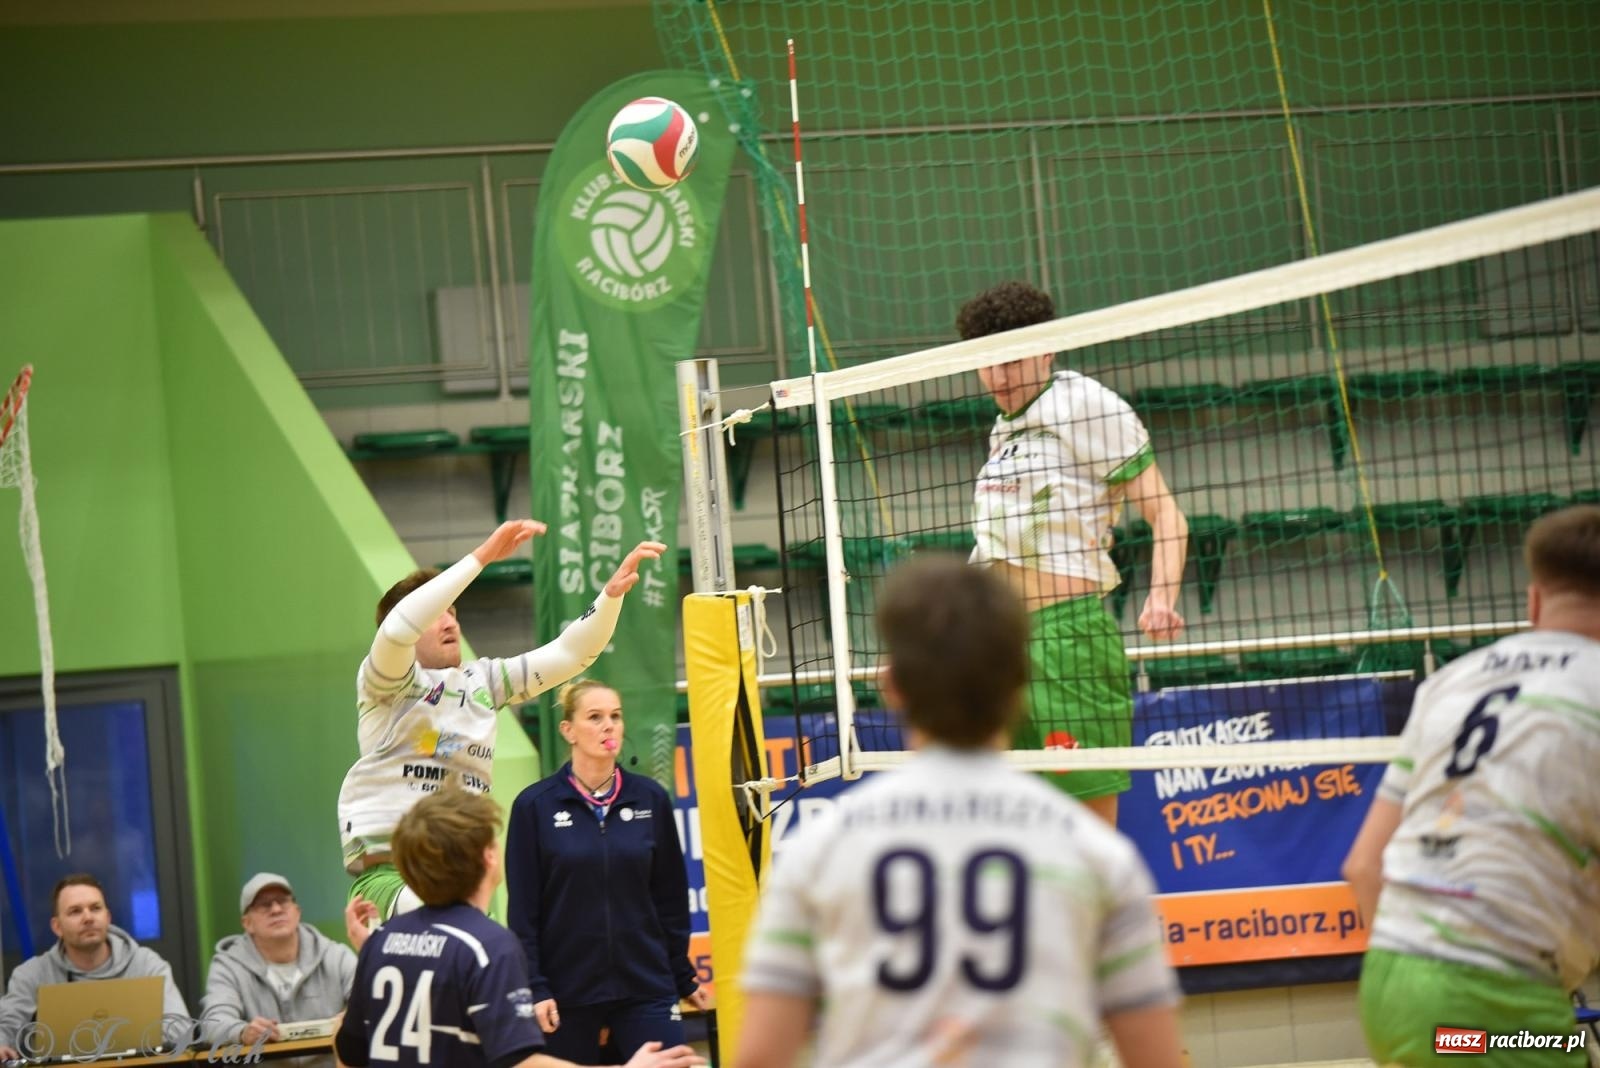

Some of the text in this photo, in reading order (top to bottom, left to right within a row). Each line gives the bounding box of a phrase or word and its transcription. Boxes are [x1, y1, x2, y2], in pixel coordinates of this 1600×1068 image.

[570, 173, 612, 220] KLUB
[575, 256, 672, 302] RACIBÓRZ
[457, 689, 466, 708] 7
[1445, 683, 1521, 779] 6
[467, 743, 495, 760] GUA
[402, 763, 449, 782] POMP
[1153, 766, 1209, 800] NAM
[1162, 764, 1362, 834] PRZEKONAJ SIĘ
[1171, 841, 1184, 870] I
[872, 846, 1030, 993] 99
[382, 931, 449, 958] URBAŃSKI
[369, 965, 435, 1064] 24
